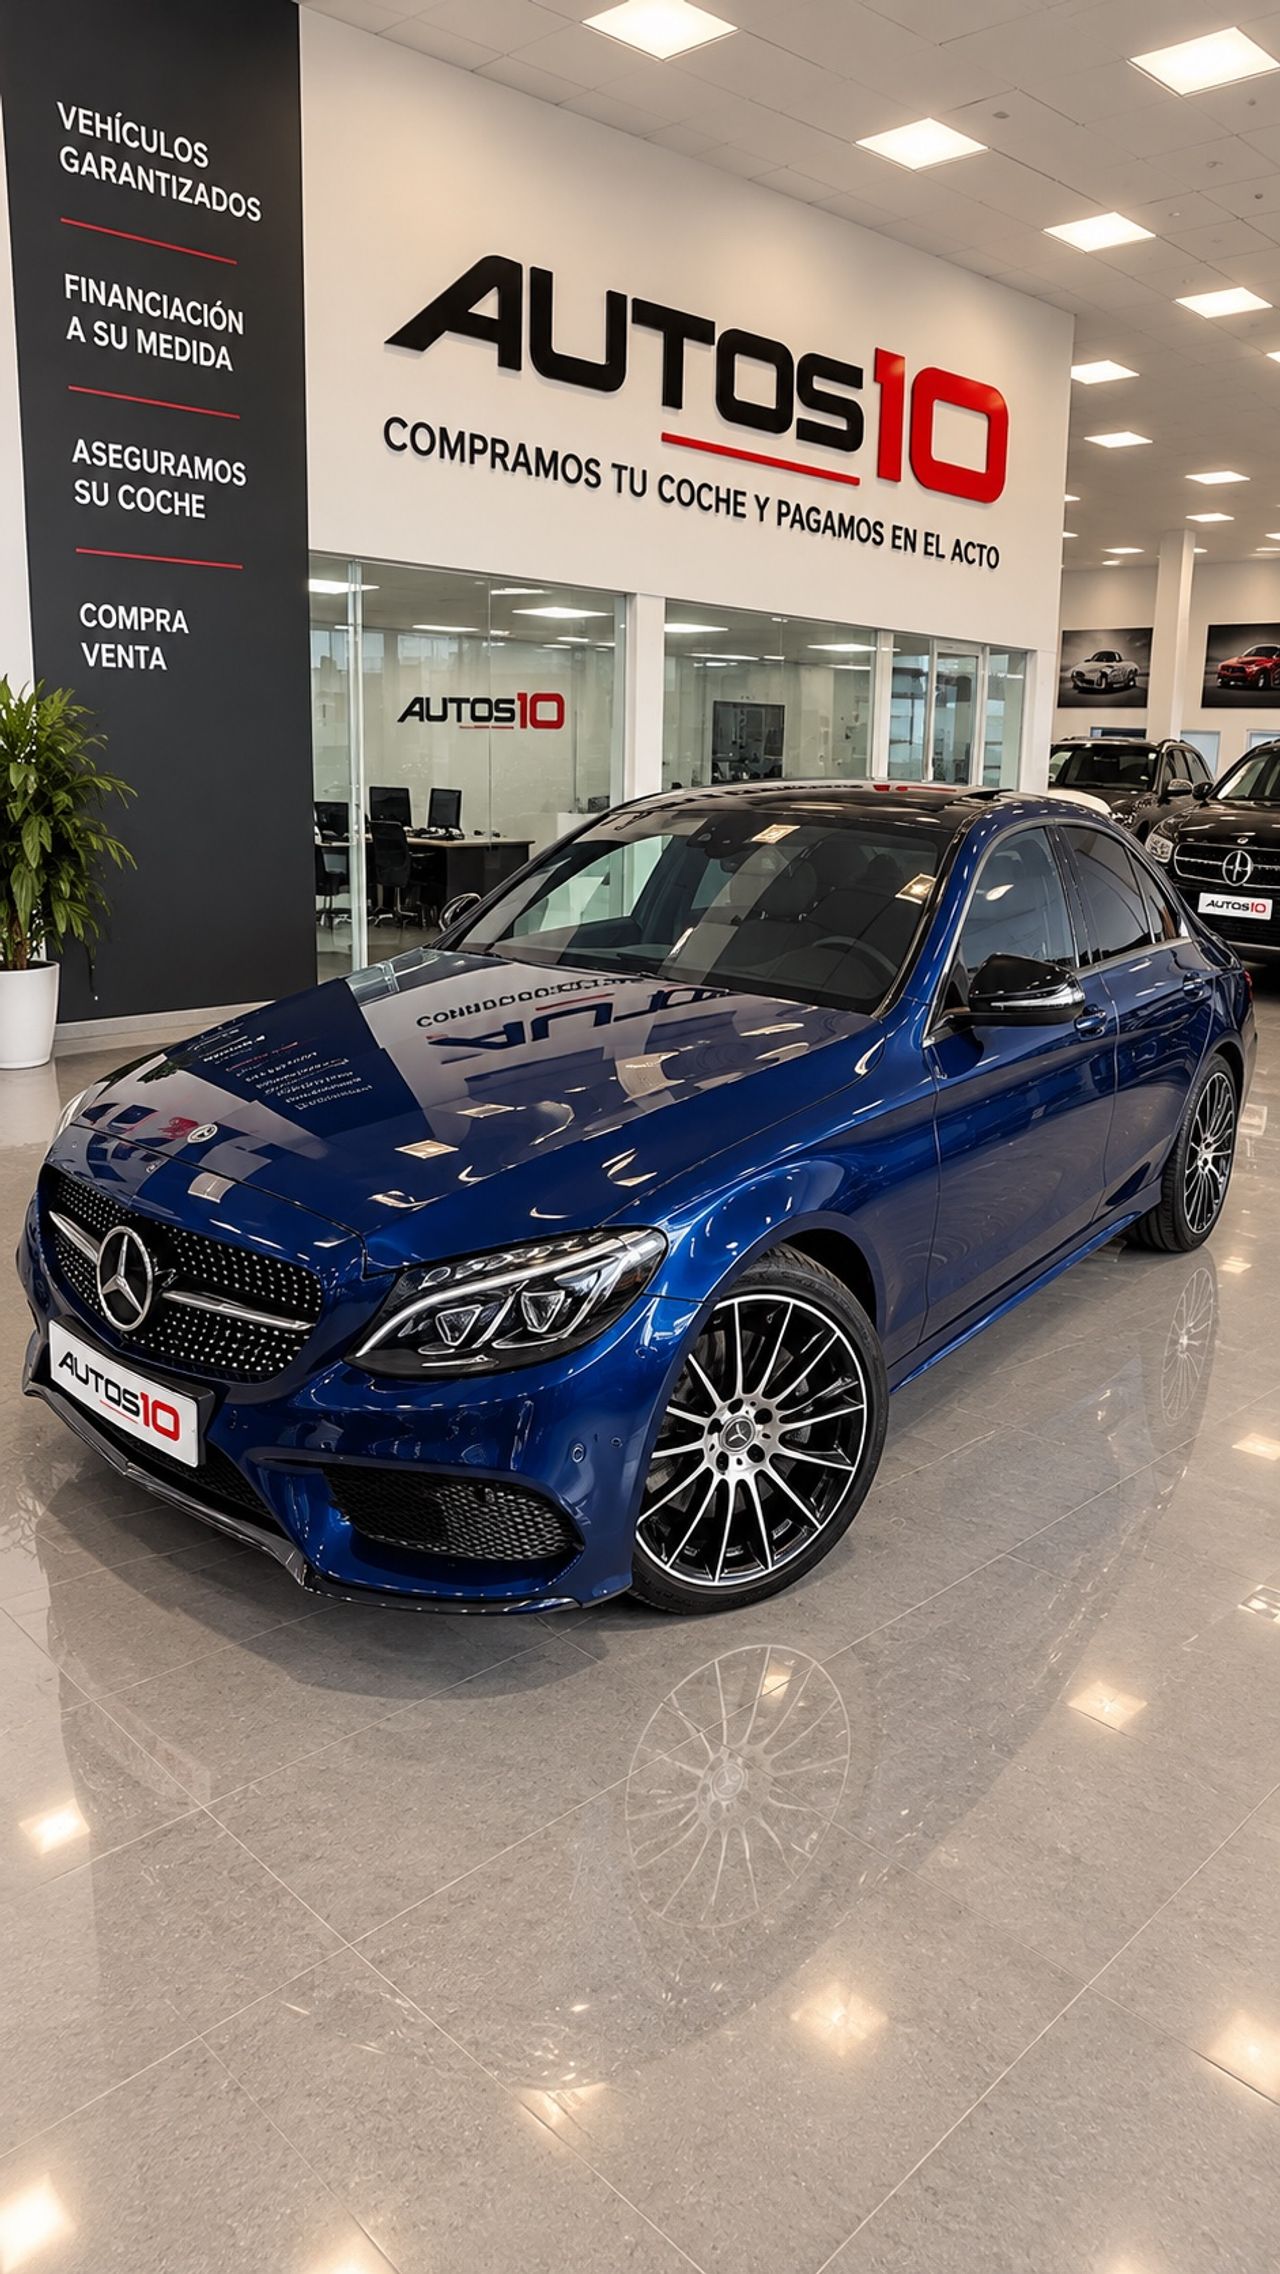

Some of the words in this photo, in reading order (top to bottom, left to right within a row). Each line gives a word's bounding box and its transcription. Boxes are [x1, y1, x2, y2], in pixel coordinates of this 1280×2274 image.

[56, 101, 209, 168] VEHÍCULOS
[59, 145, 262, 222] GARANTIZADOS
[64, 273, 244, 335] FINANCIACIÓN
[66, 315, 87, 343] A
[93, 320, 128, 350] SU
[136, 328, 234, 372] MEDIDA
[384, 255, 1009, 504] AUTOS10
[71, 438, 247, 487] ASEGURAMOS
[74, 478, 109, 507] SU
[117, 484, 206, 519] COCHE
[383, 416, 602, 489] COMPRAMOS
[611, 462, 647, 498] TU
[657, 474, 747, 519] COCHE
[754, 494, 770, 522] Y
[777, 499, 884, 546] PAGAMOS
[891, 524, 917, 553] EN
[923, 531, 946, 559] EL
[950, 538, 1000, 570] ACTO
[79, 602, 190, 634] COMPRA
[80, 642, 168, 671] VENTA
[397, 692, 565, 730] AUTOS10
[58, 1350, 181, 1442] AUTOS10
